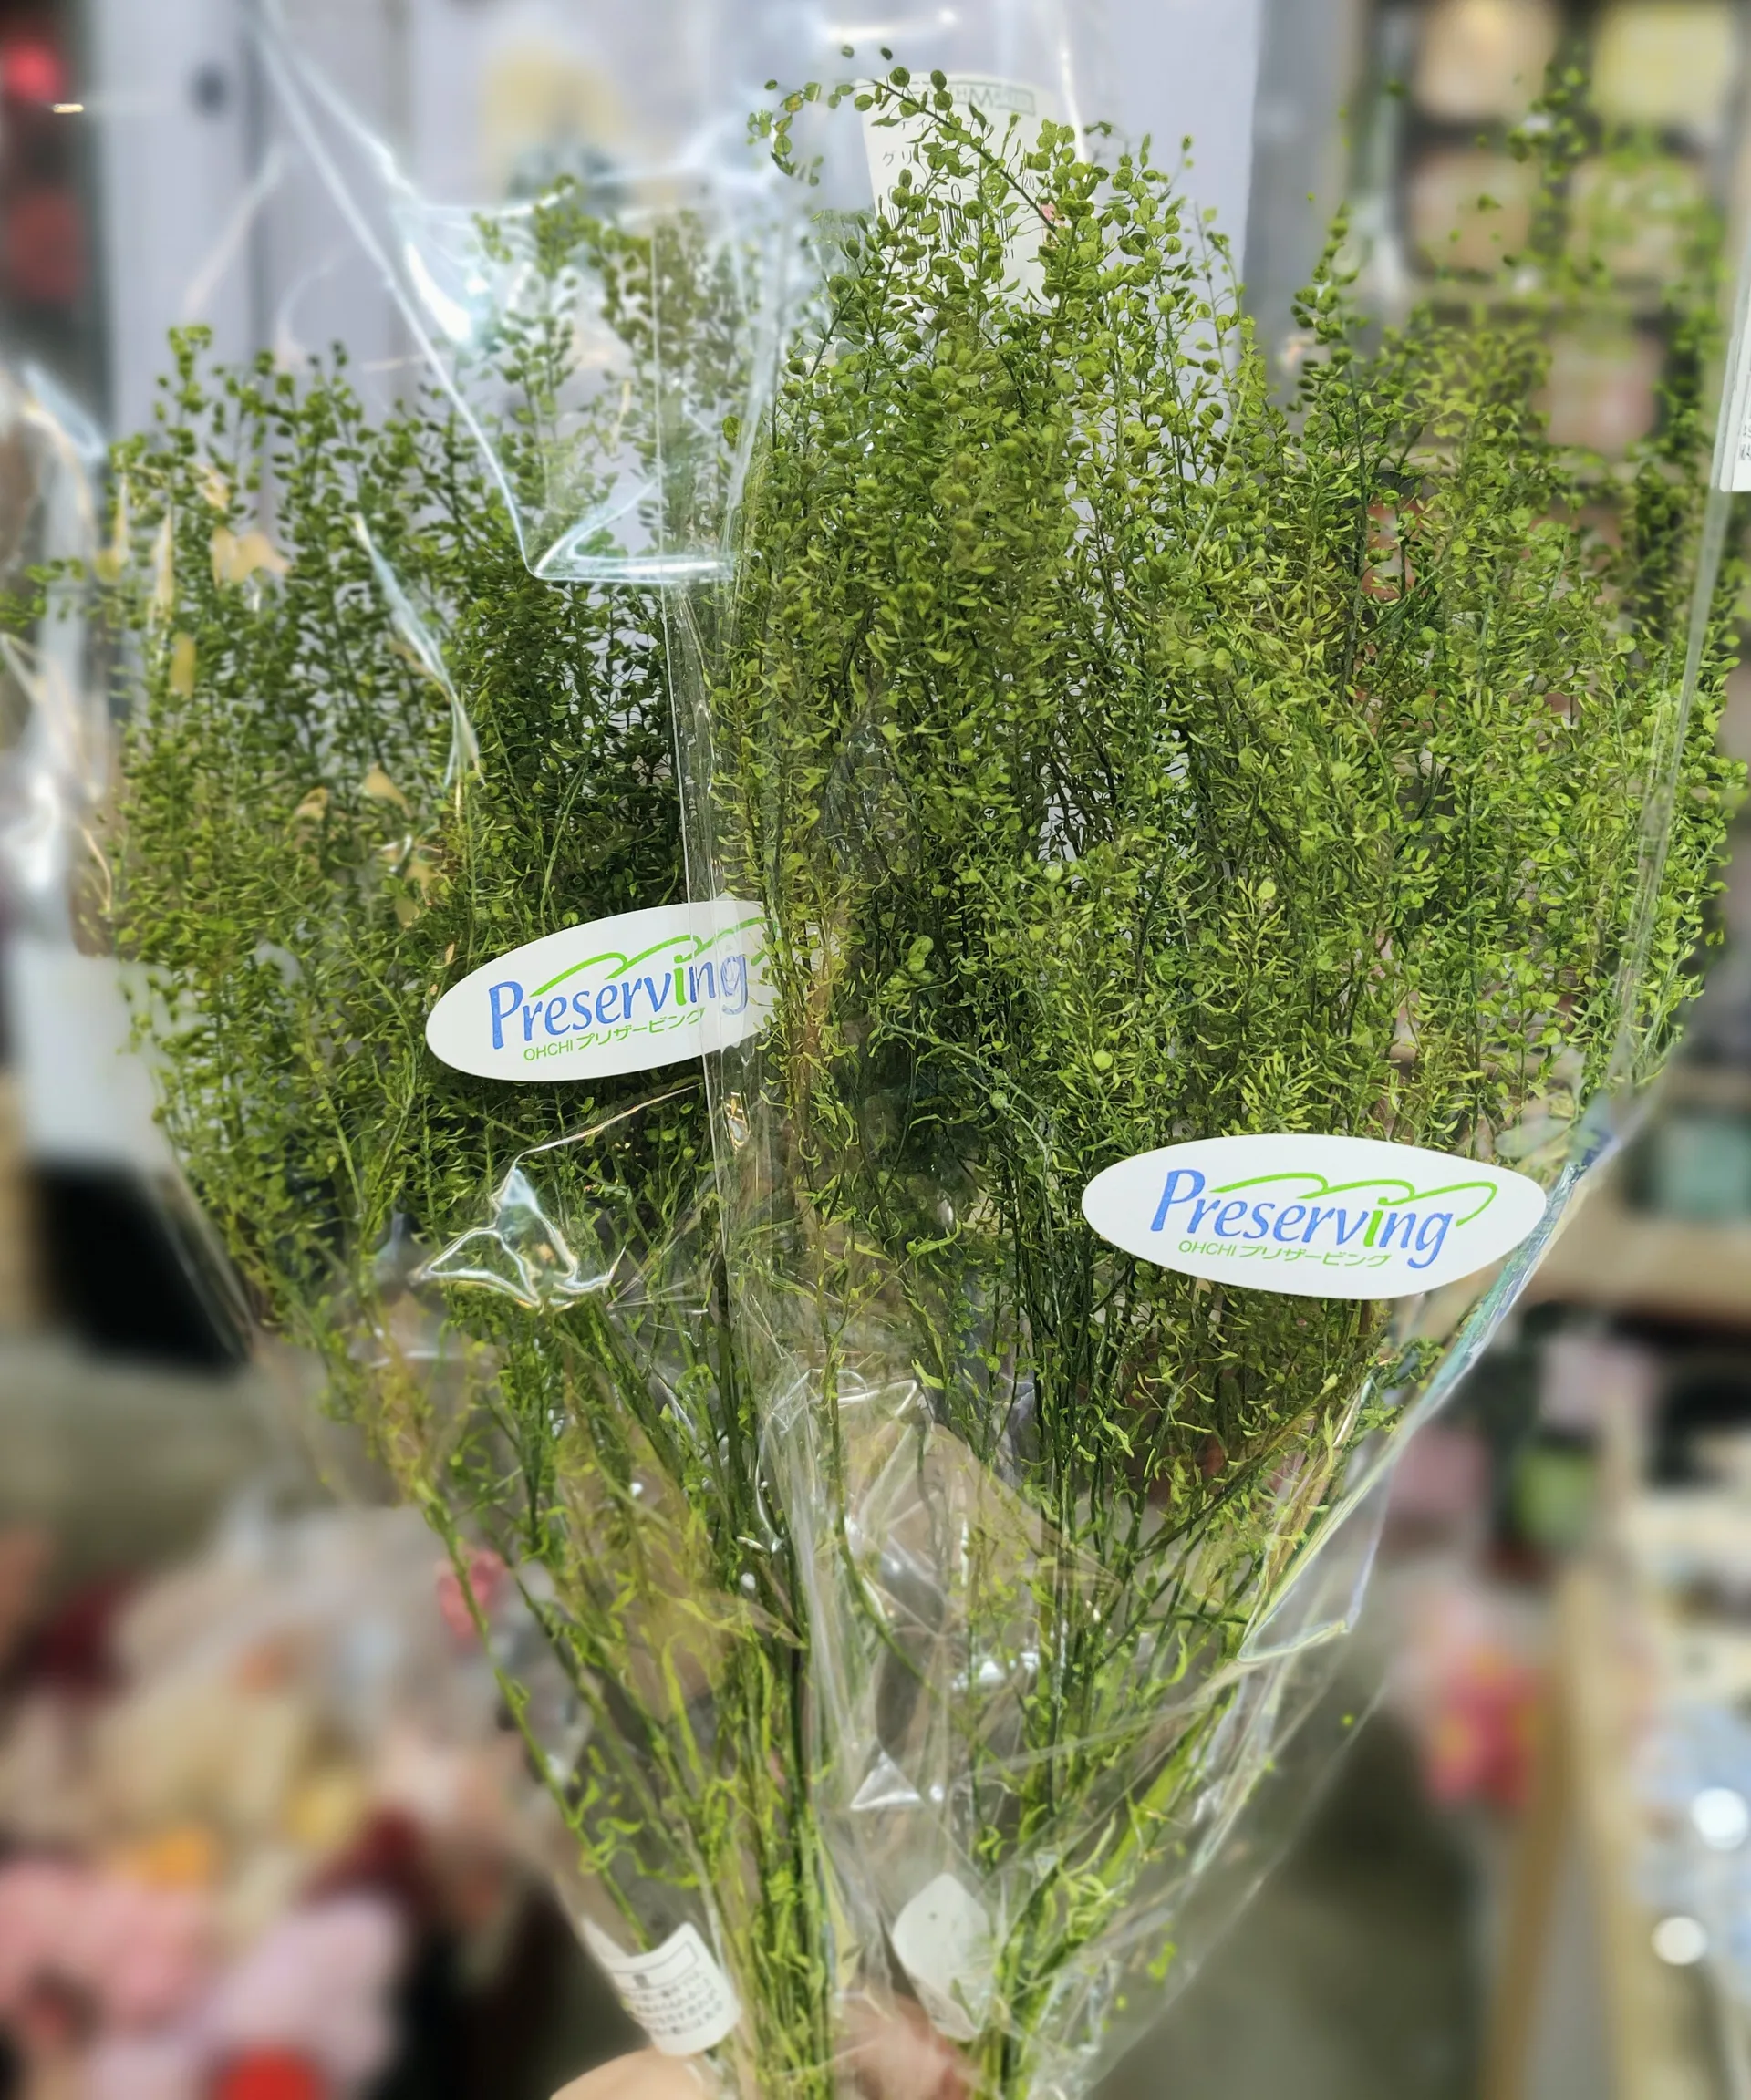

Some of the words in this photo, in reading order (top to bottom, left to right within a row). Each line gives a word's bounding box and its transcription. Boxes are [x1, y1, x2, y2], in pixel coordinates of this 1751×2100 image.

[488, 954, 749, 1050] Preserving
[523, 1039, 573, 1061] OHCHI
[576, 1008, 706, 1050] プリザービング
[1150, 1168, 1454, 1269] Preserving
[1178, 1240, 1237, 1257] OHCHI
[1238, 1245, 1392, 1267] プリザービング
